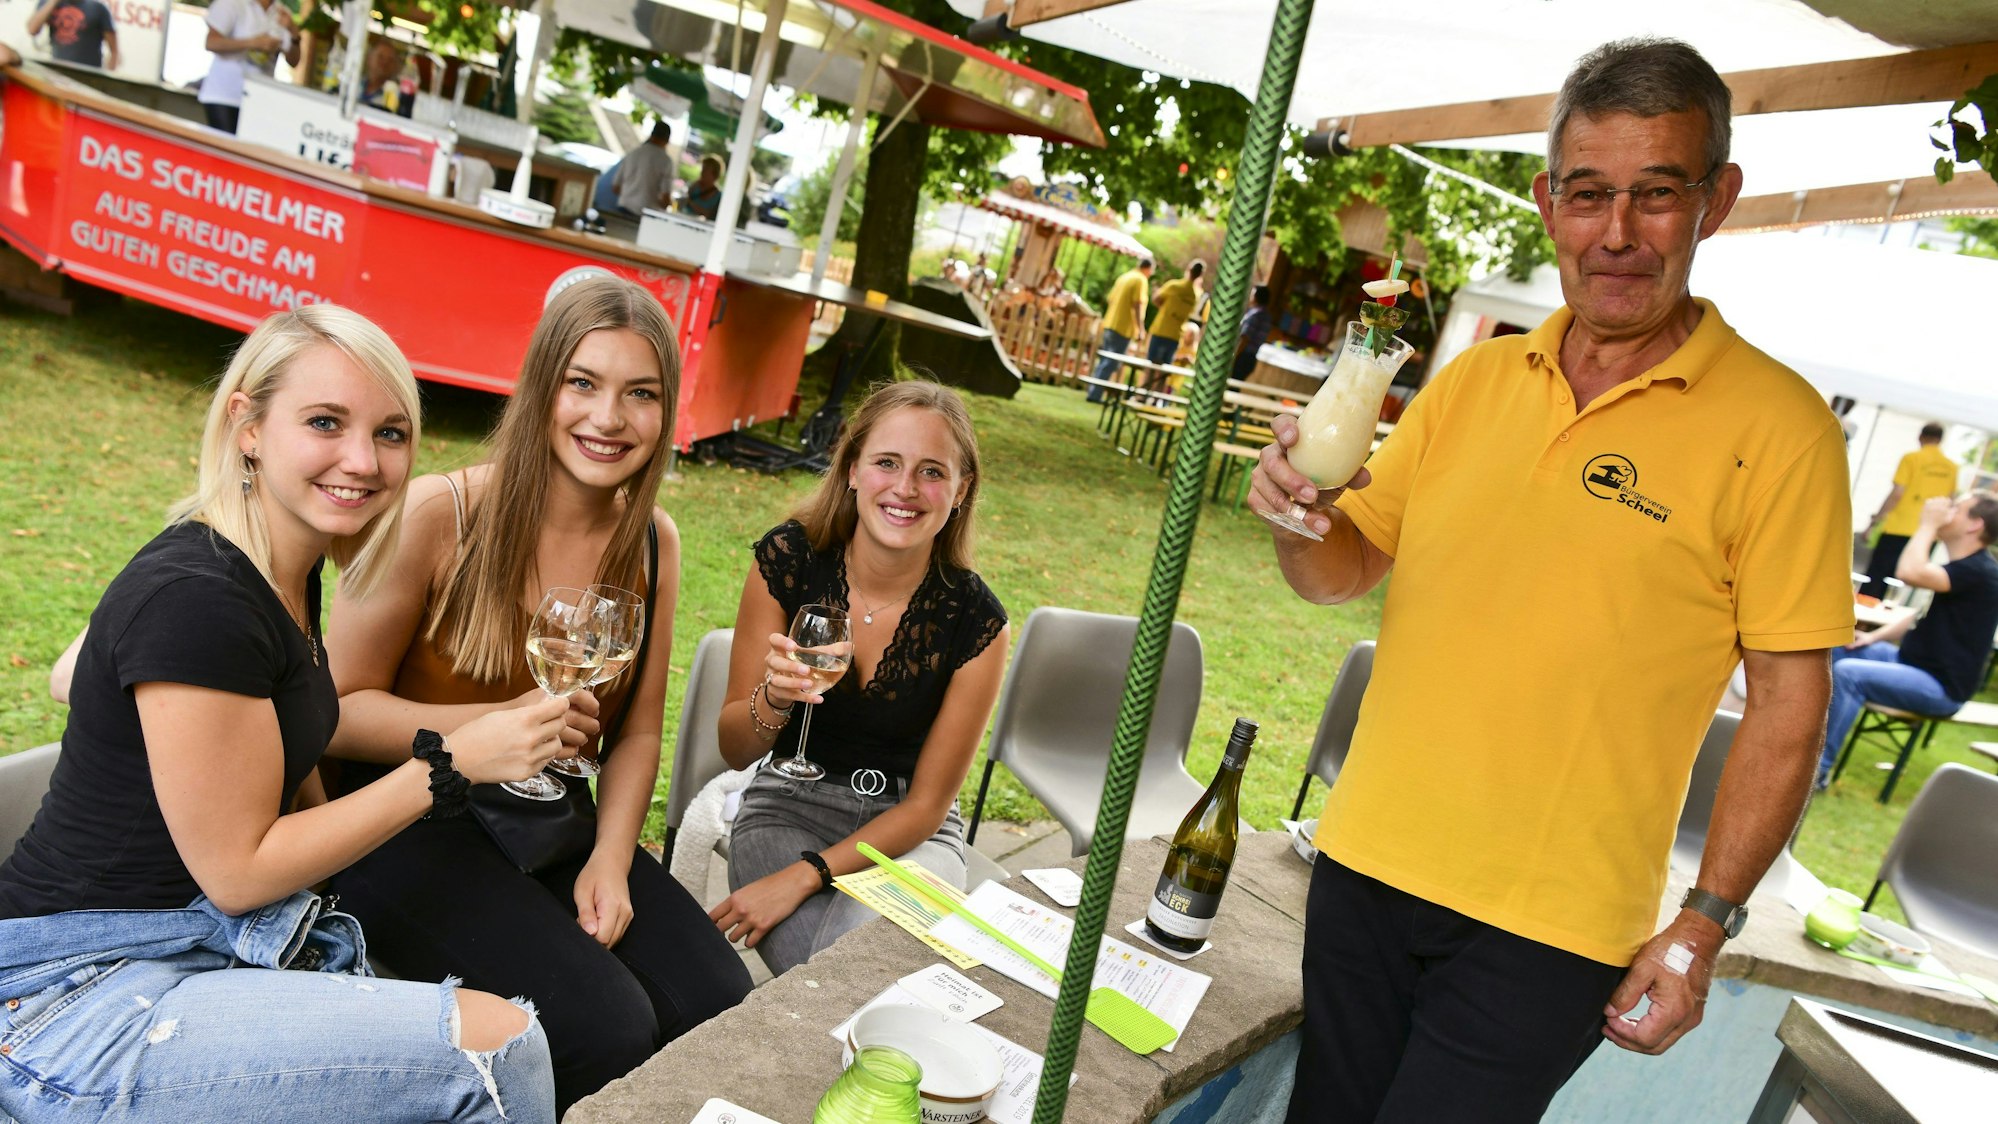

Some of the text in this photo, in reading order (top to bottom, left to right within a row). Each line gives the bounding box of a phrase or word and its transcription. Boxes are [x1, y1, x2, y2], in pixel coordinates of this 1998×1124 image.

[79, 135, 346, 244] DAS SCHWELMER
[70, 219, 160, 270] GUTEN
[95, 189, 316, 281] AUS FREUDE AM
[1616, 493, 1668, 523] Scheel
[1620, 485, 1673, 515] Bürgerverein
[1168, 898, 1190, 914] ECK
[941, 972, 983, 999] Heimat ist
[948, 983, 968, 997] mich
